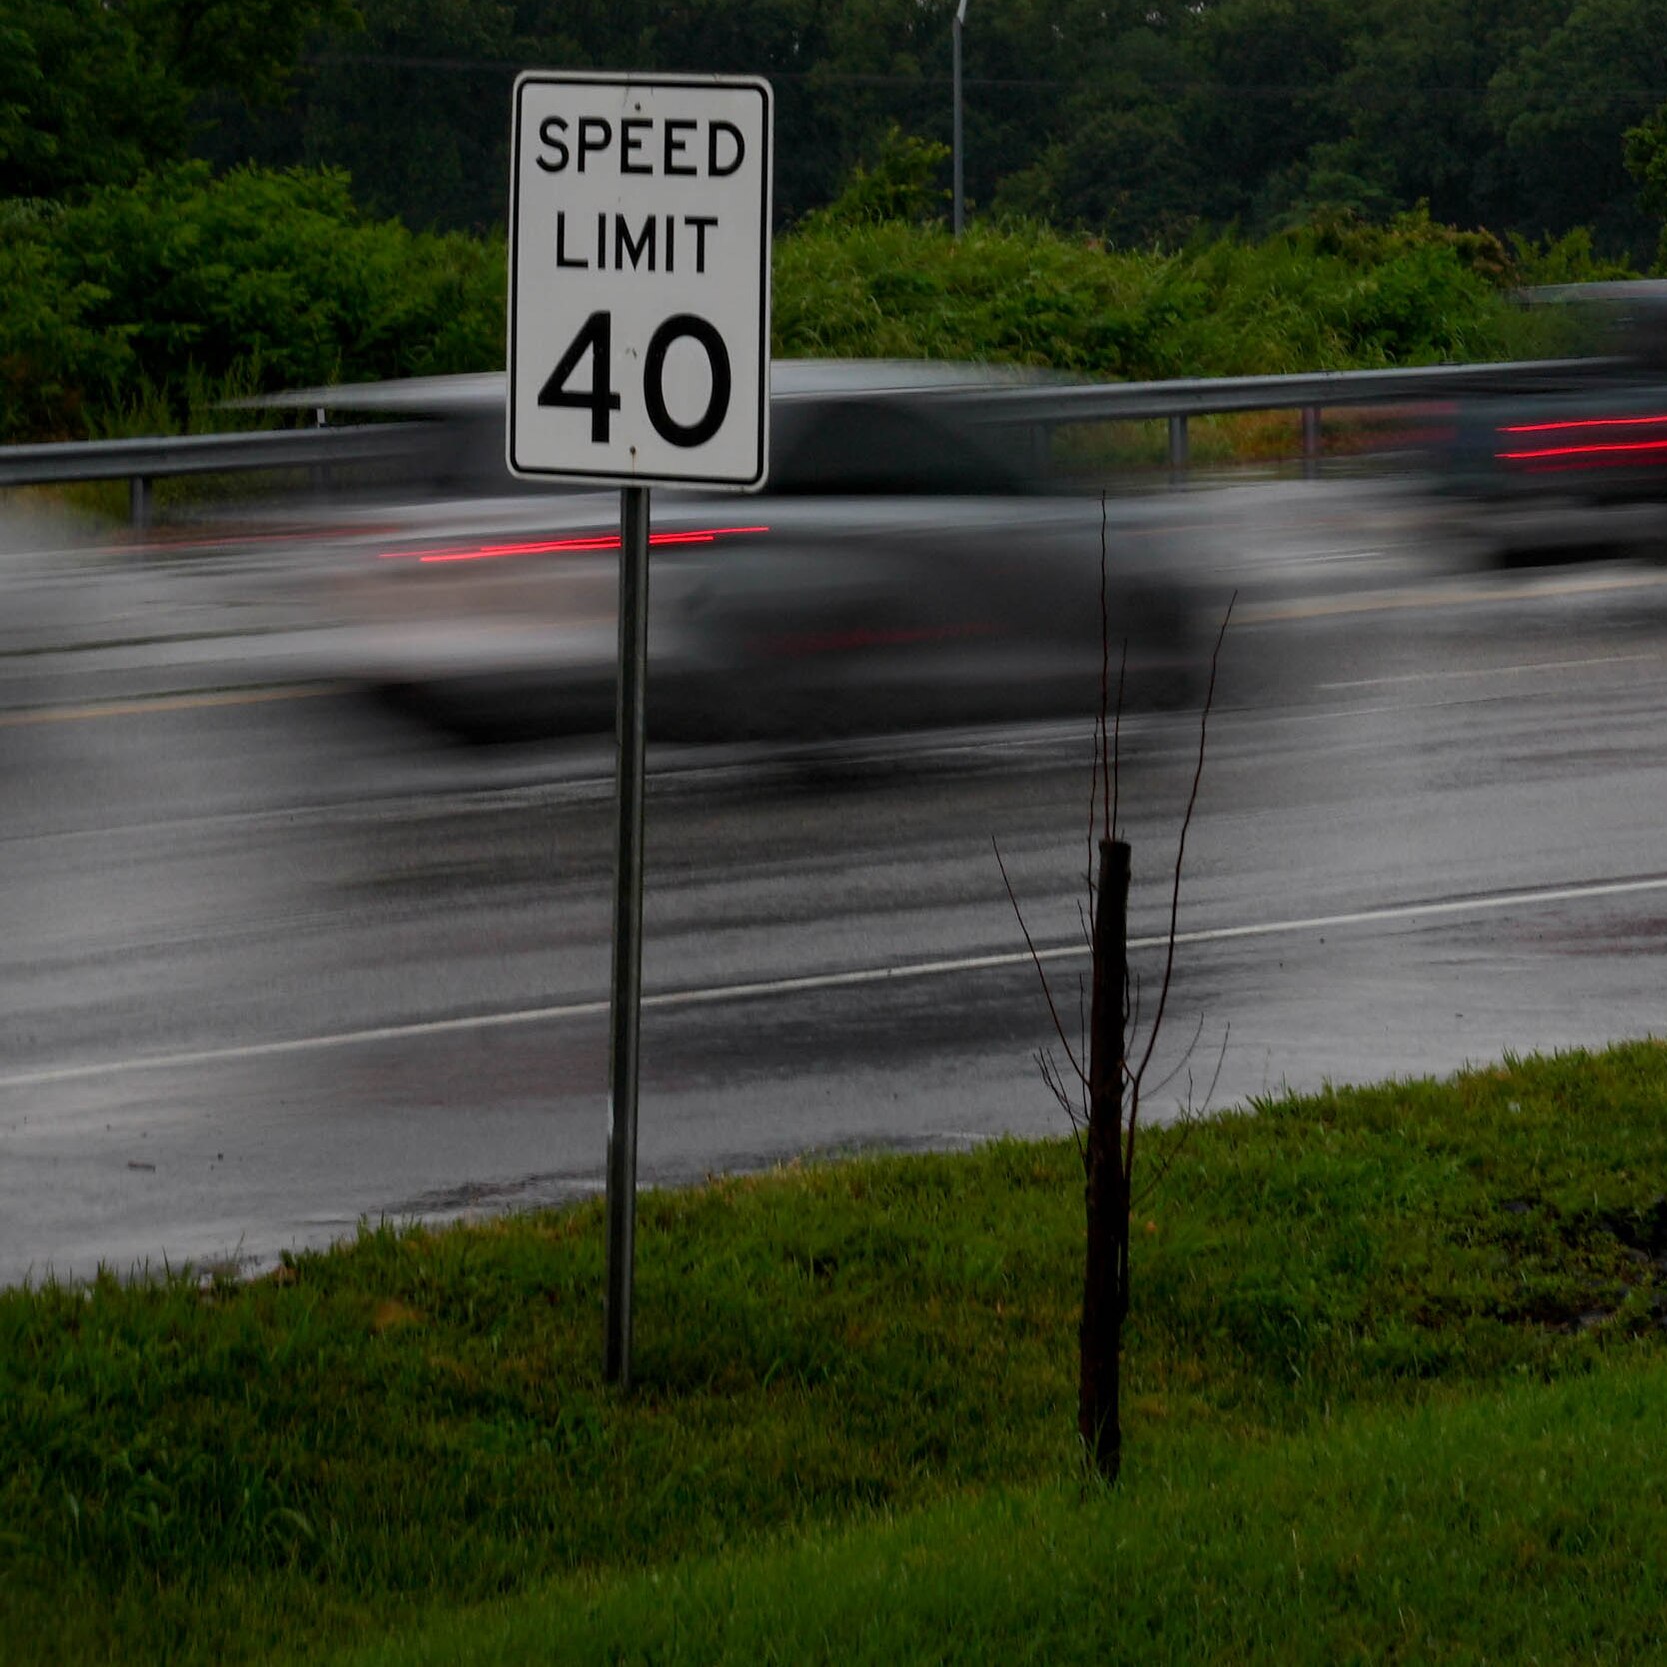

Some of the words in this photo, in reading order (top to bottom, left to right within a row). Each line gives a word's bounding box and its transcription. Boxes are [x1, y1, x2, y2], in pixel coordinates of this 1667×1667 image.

[535, 115, 746, 178] SPEED
[555, 210, 719, 274] LIMIT
[536, 309, 732, 449] 40
